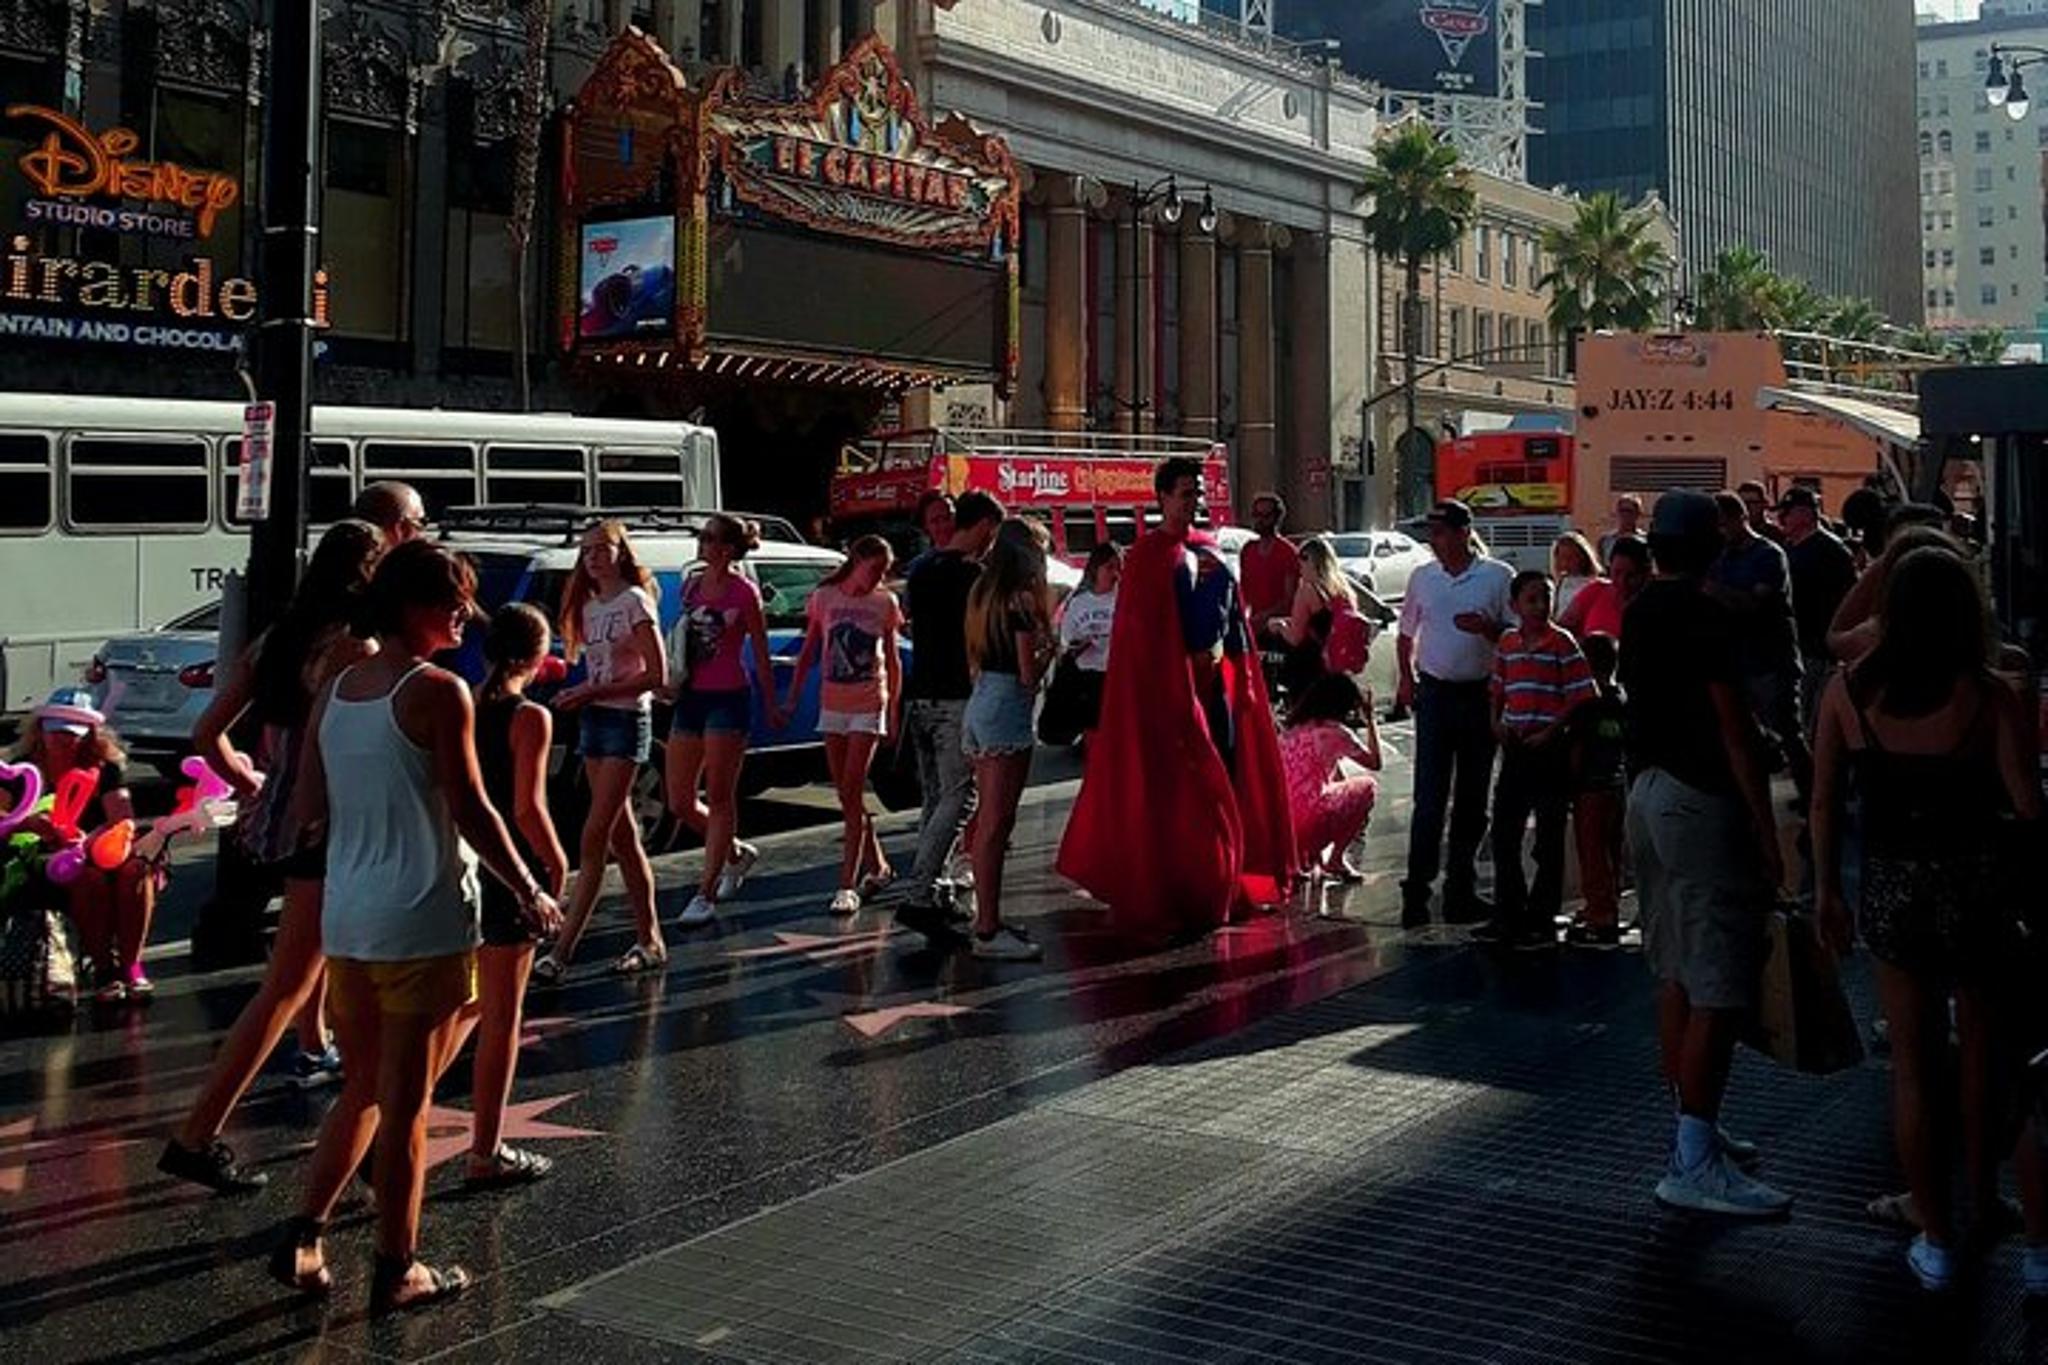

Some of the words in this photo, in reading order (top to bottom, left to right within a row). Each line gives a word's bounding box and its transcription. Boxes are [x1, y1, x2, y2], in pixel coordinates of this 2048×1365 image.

[27, 200, 116, 228] STUDIO
[119, 212, 194, 237] STORE
[78, 320, 130, 342] AND
[1607, 389, 1674, 410] JAY:Z
[1682, 389, 1734, 410] 4:44
